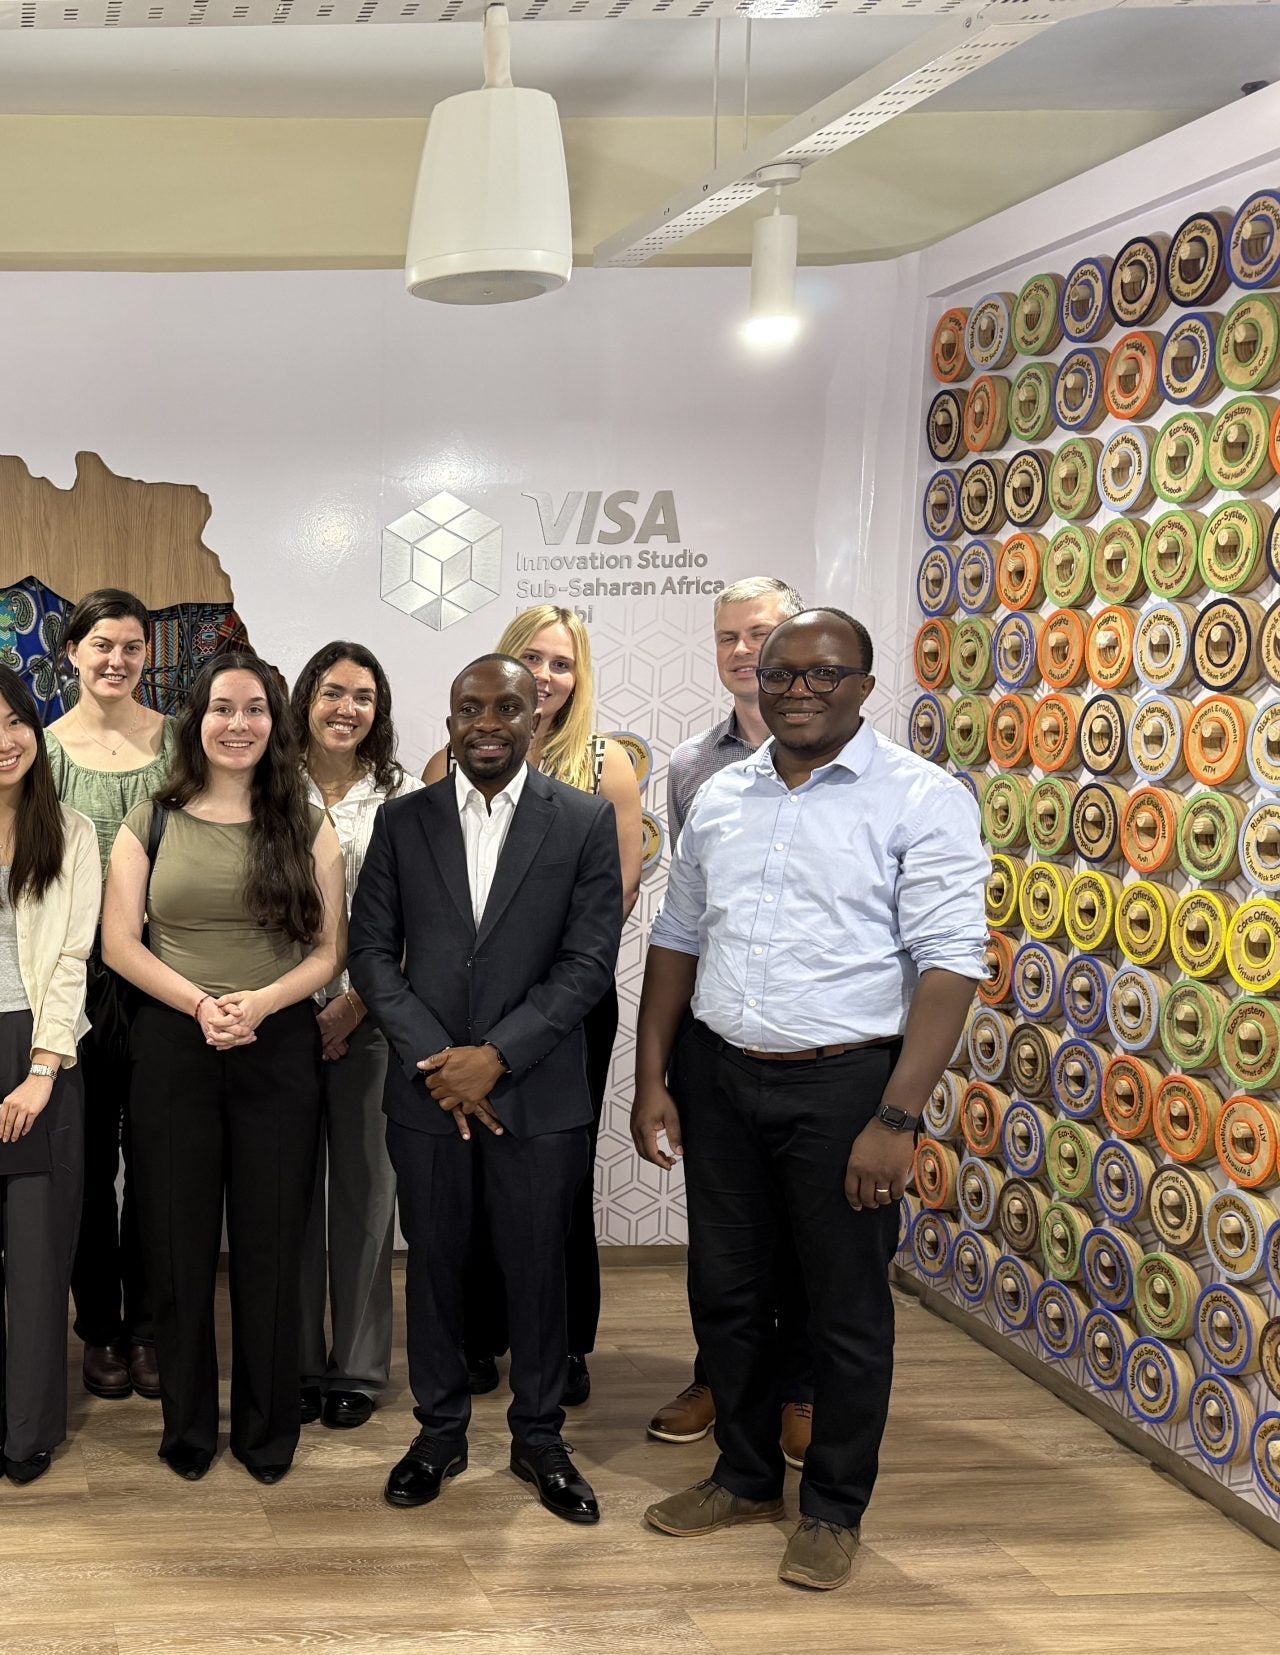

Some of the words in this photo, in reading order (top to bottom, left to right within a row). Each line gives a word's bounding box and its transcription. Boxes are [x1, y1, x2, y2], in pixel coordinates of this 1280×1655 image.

[1169, 238, 1183, 279] Product
[1182, 222, 1212, 240] Packages
[1119, 248, 1140, 272] Product
[1140, 248, 1156, 285] Packages
[1222, 307, 1252, 355] Eco-System
[1199, 329, 1209, 370] Services
[1169, 422, 1200, 446] Eco-System
[1212, 405, 1252, 443] Eco-System
[1108, 440, 1121, 455] Risk
[1121, 435, 1143, 475] Management
[1006, 460, 1023, 489] Product
[521, 490, 681, 545] VISA
[1155, 520, 1188, 539] Eco-System
[1210, 511, 1248, 536] Eco-System
[516, 551, 632, 571] Innovation
[637, 548, 709, 570] Studio
[516, 577, 657, 599] Sub-Saharan
[661, 575, 725, 595] Africa
[1049, 616, 1069, 630] Insights
[1097, 612, 1118, 629] Insights
[1142, 621, 1153, 637] Risk
[1153, 614, 1181, 648] Management
[1199, 610, 1221, 638] Product
[1221, 609, 1243, 643] Packages
[1135, 713, 1146, 731] Risk
[1145, 706, 1176, 737] Management
[1192, 706, 1214, 735] Payment
[1214, 704, 1238, 744] Enablement
[1257, 713, 1270, 734] Risk
[617, 738, 646, 760] nagement
[1202, 765, 1217, 774] ATM
[1145, 797, 1167, 839] Enablement
[1250, 814, 1264, 831] Risk
[1025, 878, 1035, 896] Core
[1034, 870, 1057, 889] Offerings
[1075, 882, 1088, 896] Core
[1087, 880, 1107, 909] Offerings
[1122, 898, 1133, 917] Core
[1132, 890, 1158, 911] Offerings
[1178, 906, 1191, 928] Core
[1190, 899, 1218, 921] Offerings
[1237, 915, 1254, 934] Core
[1237, 963, 1255, 982] Virtual
[1256, 969, 1271, 982] Card
[1227, 1006, 1265, 1035] Eco-System
[1214, 1199, 1229, 1213] Risk
[1229, 1199, 1257, 1252] Management
[1144, 1346, 1167, 1370] Services
